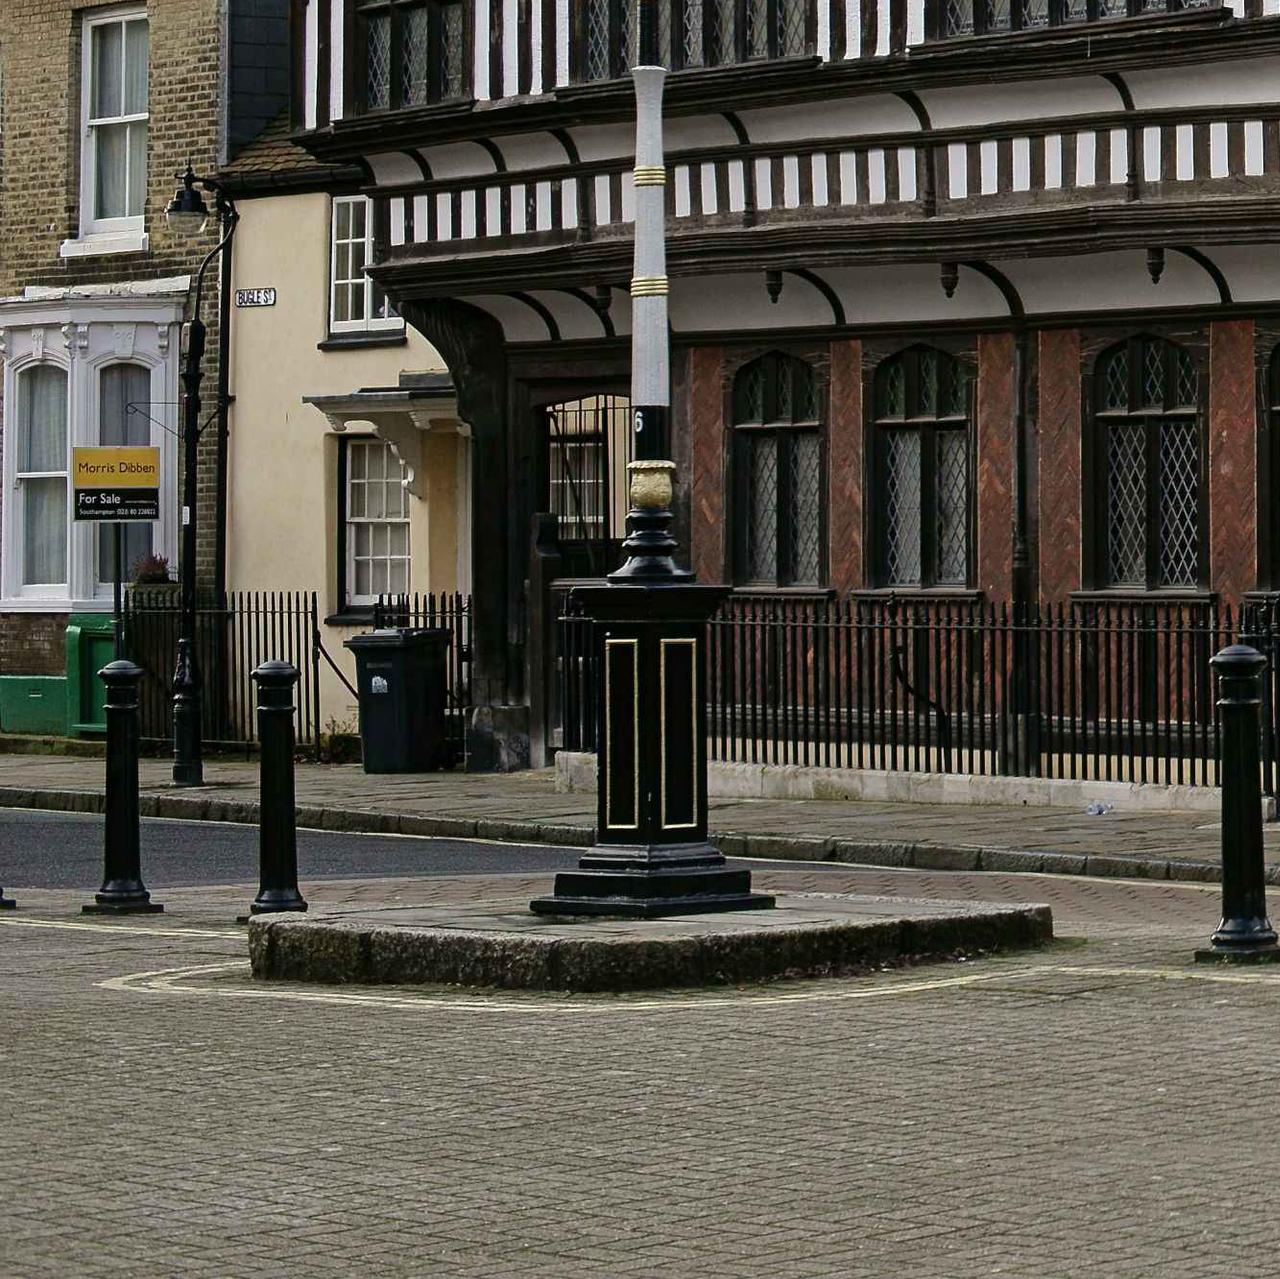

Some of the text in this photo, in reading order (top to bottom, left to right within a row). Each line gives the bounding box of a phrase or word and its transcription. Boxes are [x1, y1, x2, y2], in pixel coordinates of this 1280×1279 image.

[238, 290, 261, 305] BUGLE
[78, 462, 155, 473] Morris Dibben
[79, 493, 121, 504] For Sale
[79, 508, 115, 517] Southampton
